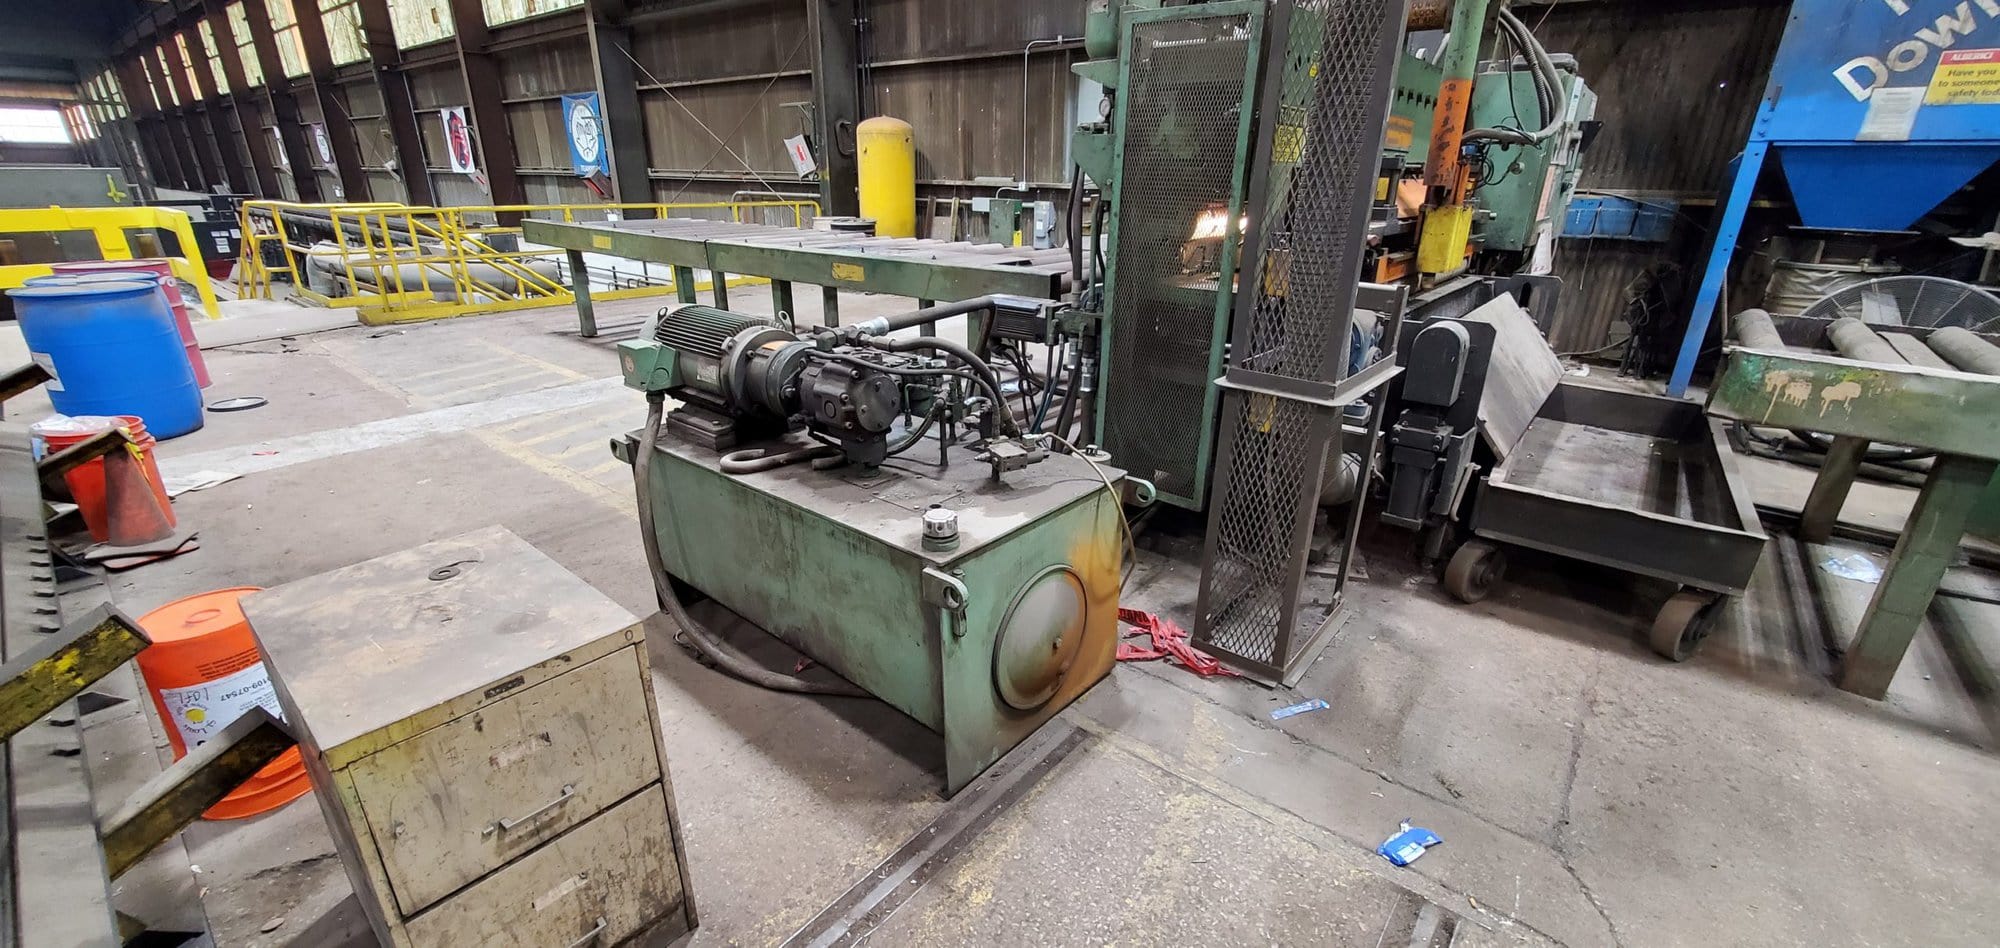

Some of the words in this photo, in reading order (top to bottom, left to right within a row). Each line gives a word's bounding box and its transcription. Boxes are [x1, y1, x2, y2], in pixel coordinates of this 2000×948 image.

[1947, 69, 1975, 77] Have
[1977, 69, 1998, 78] you
[1947, 90, 1979, 98] safety
